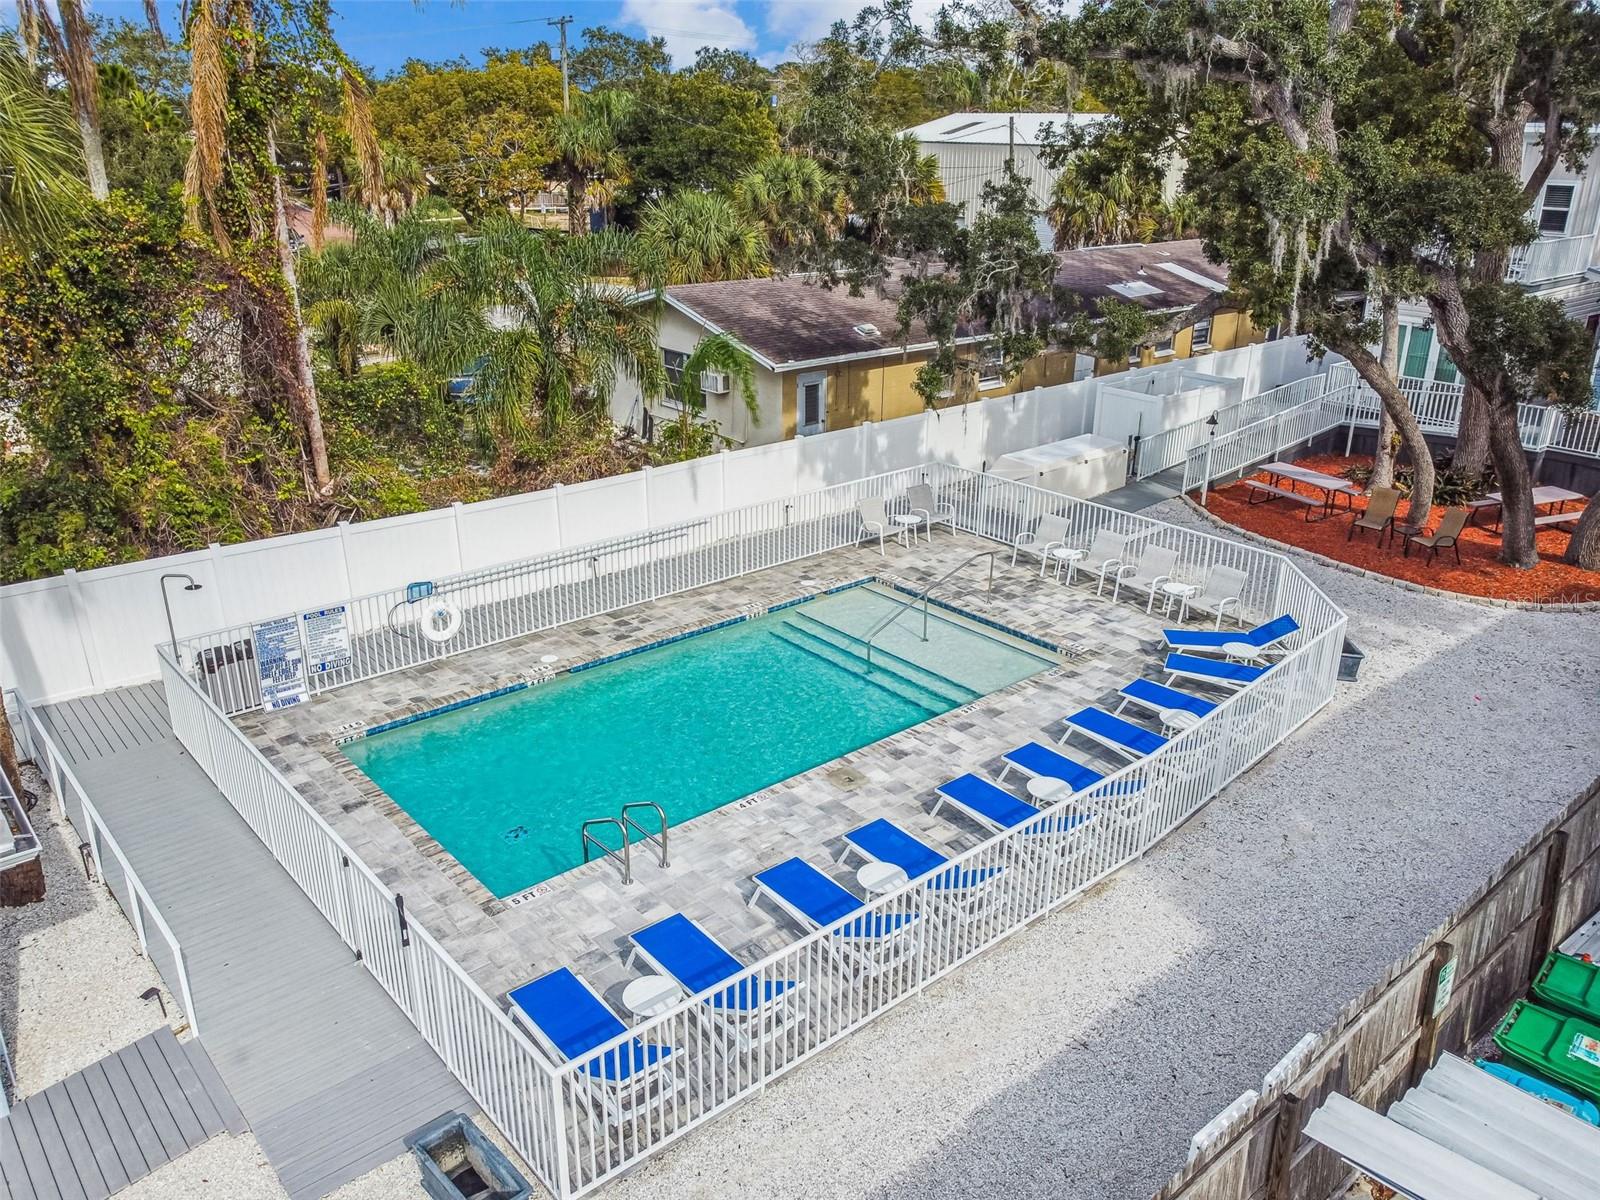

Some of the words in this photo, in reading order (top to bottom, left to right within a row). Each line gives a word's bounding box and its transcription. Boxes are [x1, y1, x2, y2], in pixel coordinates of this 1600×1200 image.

[311, 664, 322, 673] NO
[325, 657, 351, 670] DIVING
[272, 700, 280, 709] NO
[280, 695, 300, 707] DIVING
[745, 797, 758, 805] FT
[511, 897, 521, 905] 5
[522, 891, 536, 901] FT
